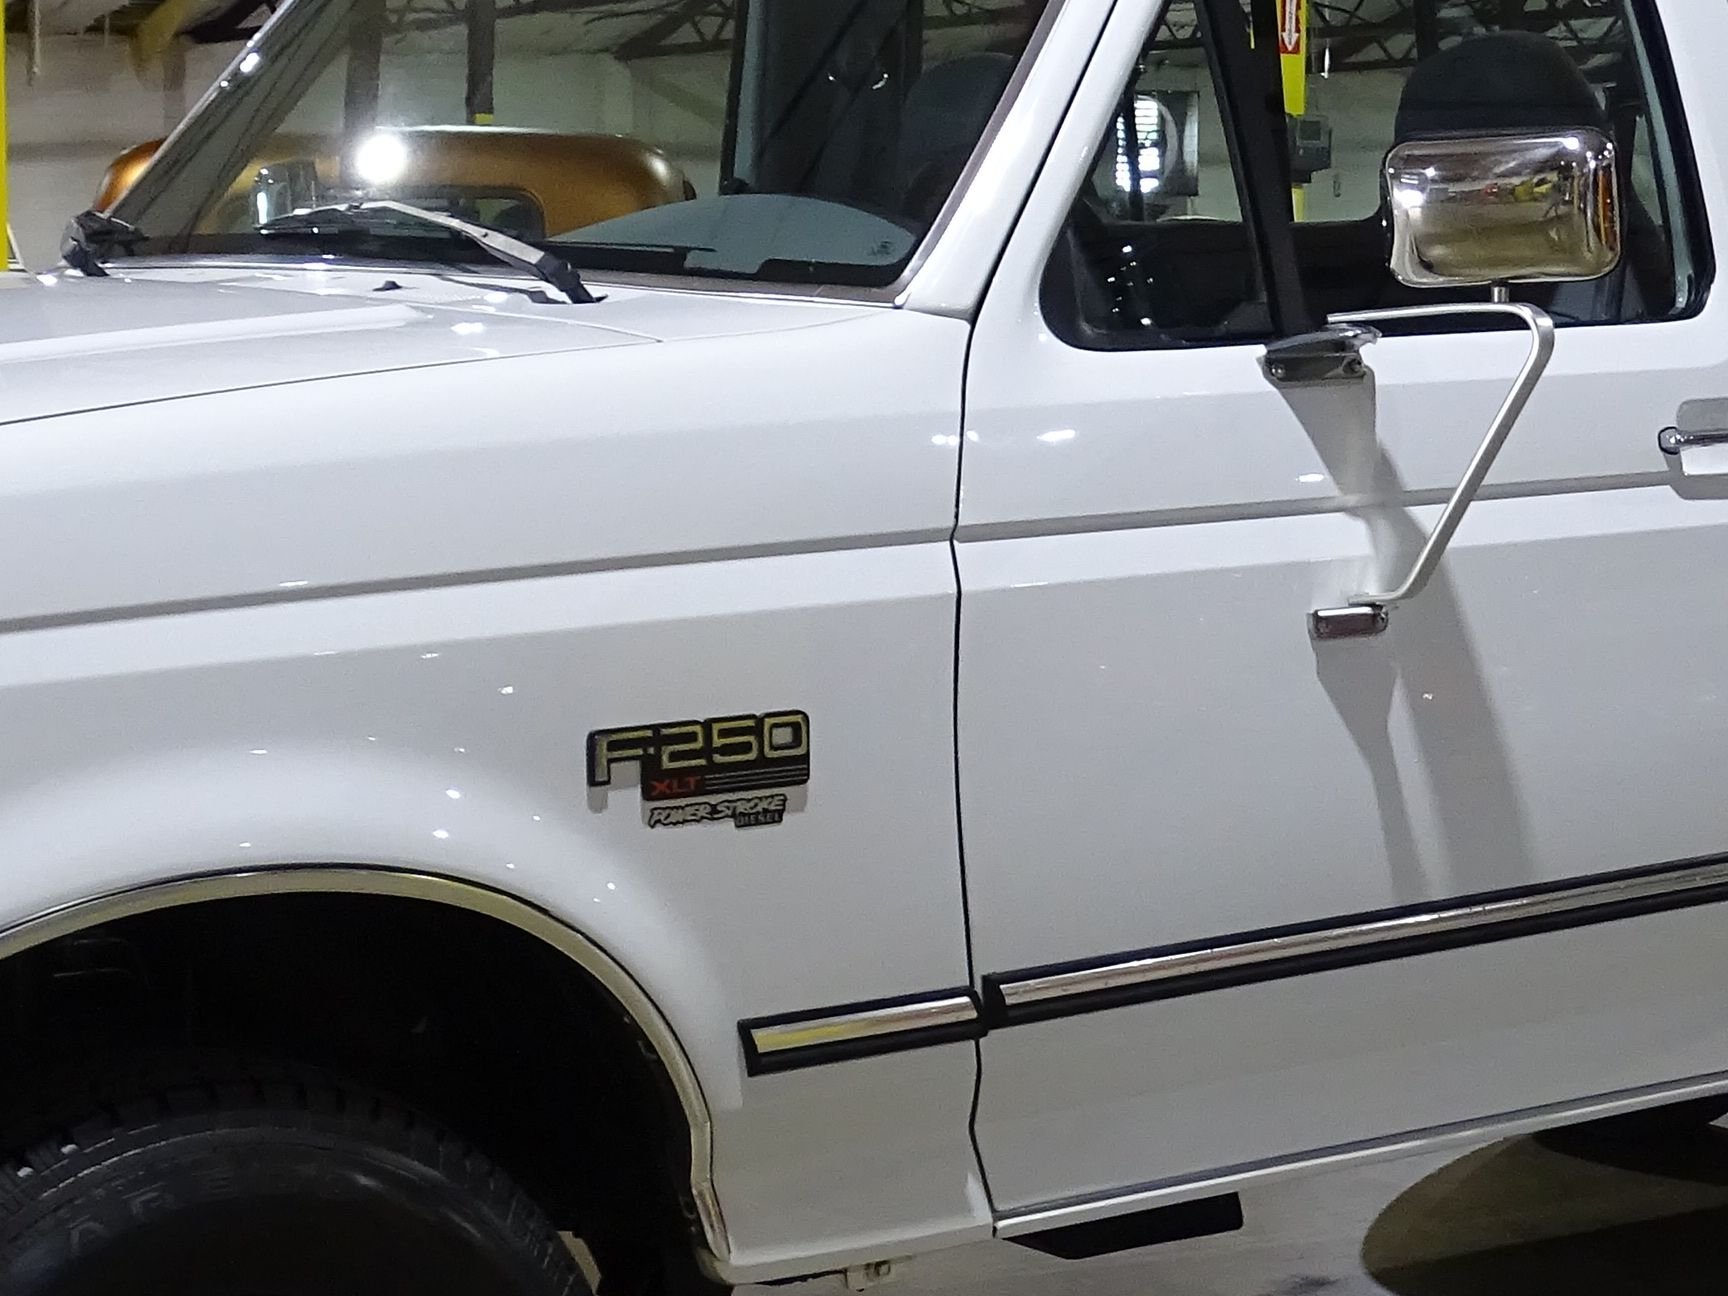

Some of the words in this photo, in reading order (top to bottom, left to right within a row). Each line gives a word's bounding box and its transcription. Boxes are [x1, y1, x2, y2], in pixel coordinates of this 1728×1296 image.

[649, 775, 702, 796] XLT
[649, 802, 712, 828] POWER
[715, 794, 787, 821] STROKE
[736, 810, 782, 828] DIESEL
